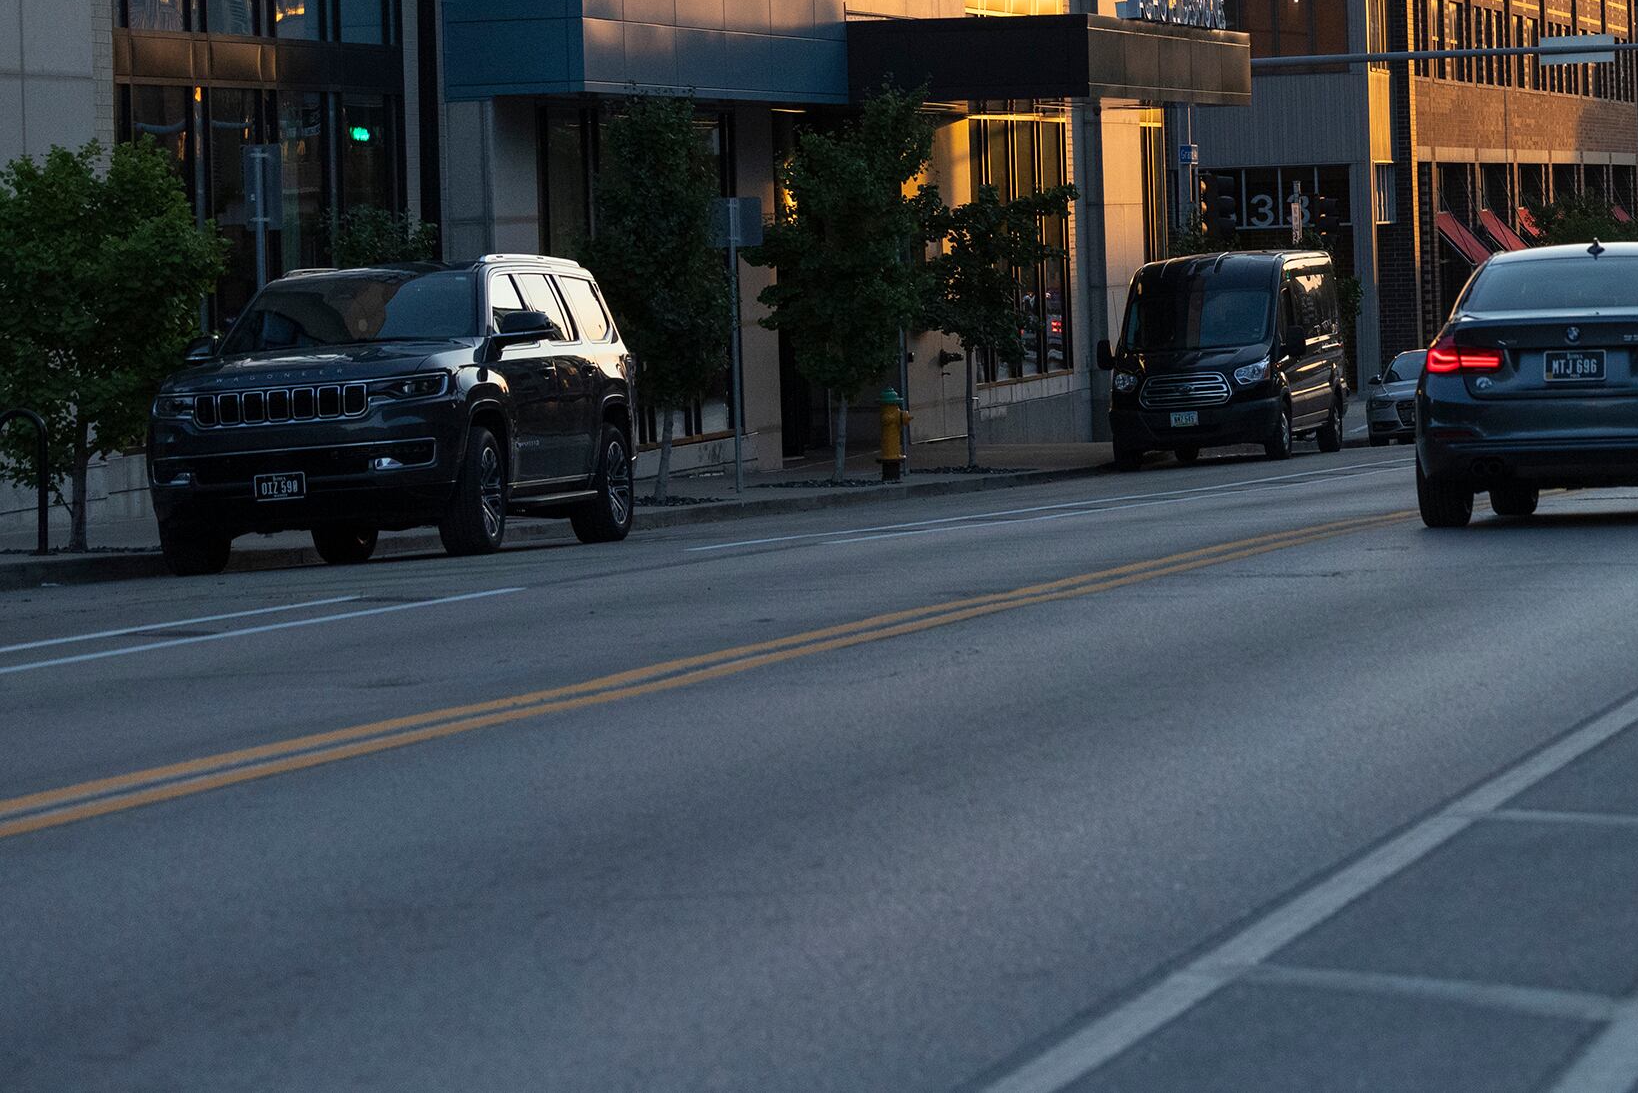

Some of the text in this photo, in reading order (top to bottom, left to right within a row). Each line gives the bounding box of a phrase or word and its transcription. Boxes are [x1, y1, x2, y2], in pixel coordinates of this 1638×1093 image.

[1552, 358, 1597, 374] MTJ 696
[216, 368, 343, 383] WAGONEER
